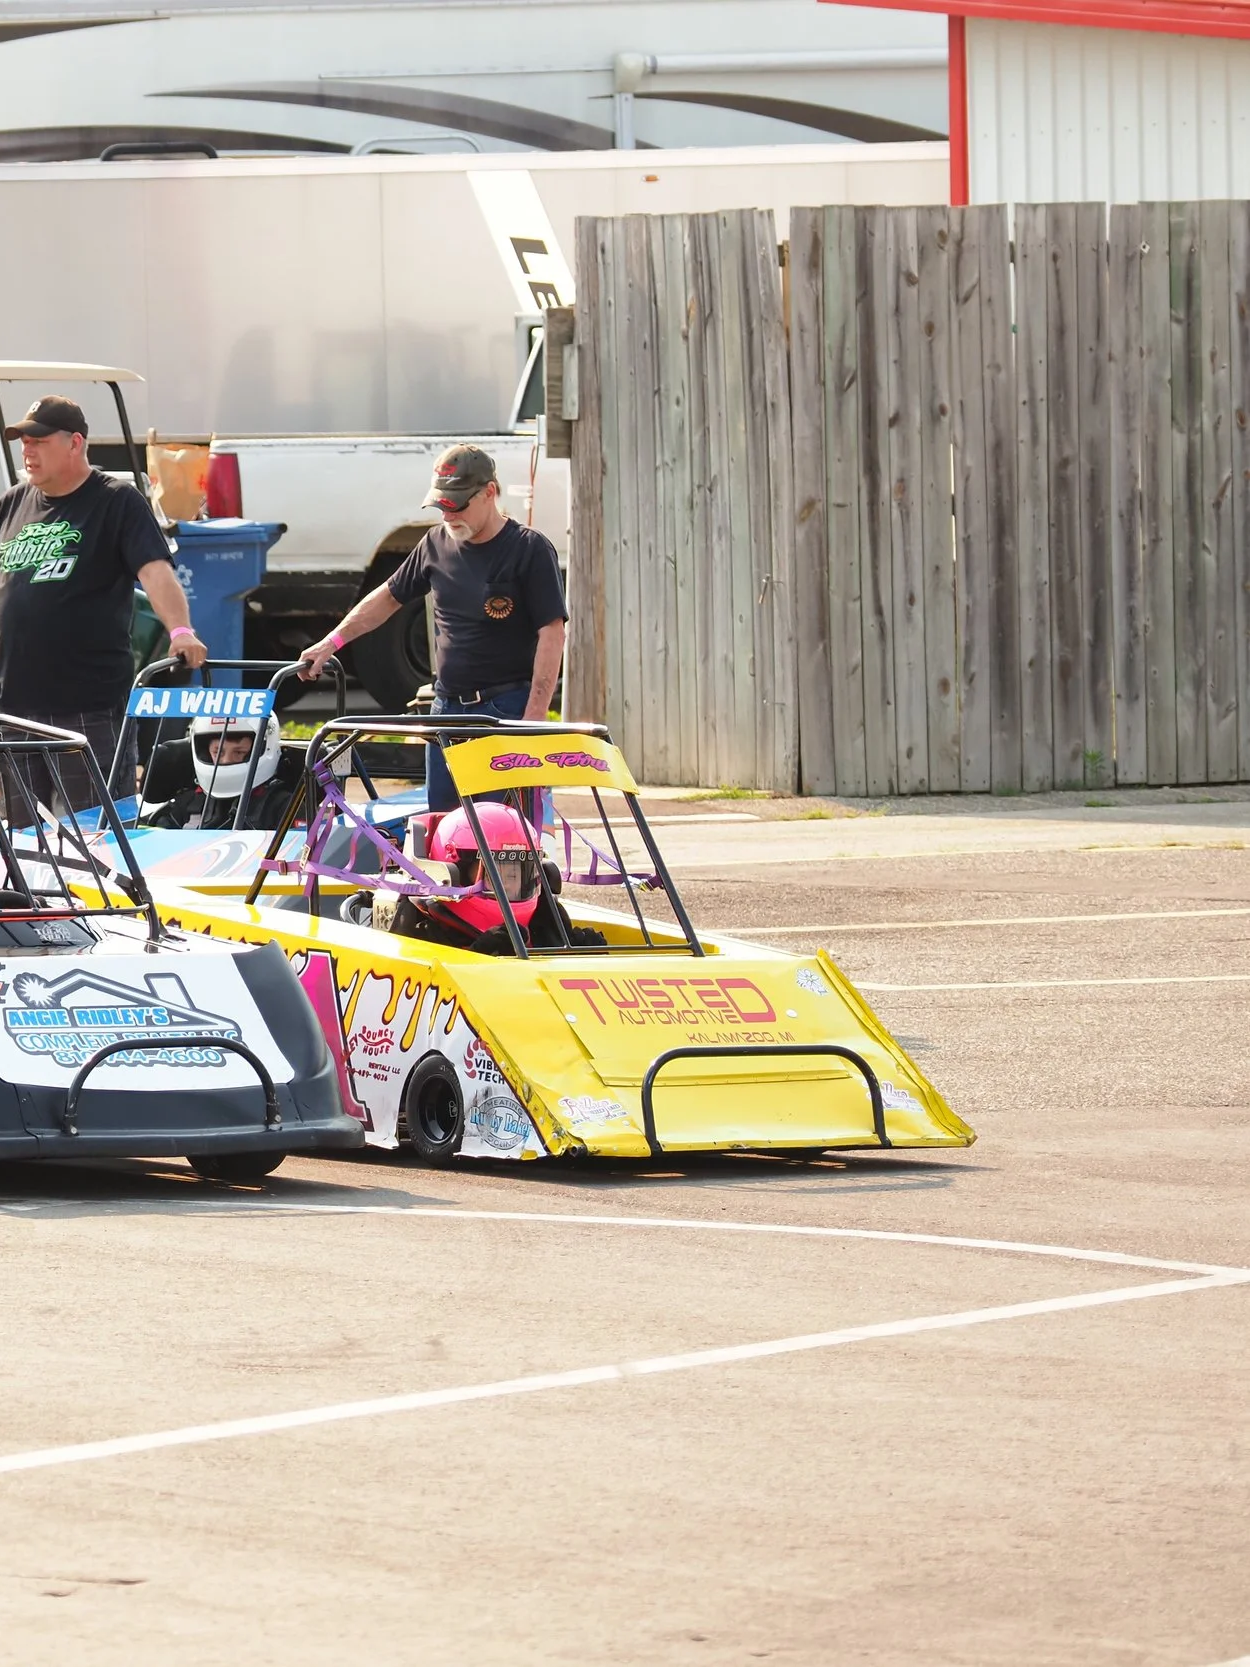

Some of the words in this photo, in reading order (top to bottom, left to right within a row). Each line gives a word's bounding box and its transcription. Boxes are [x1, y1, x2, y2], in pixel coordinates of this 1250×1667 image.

[31, 556, 77, 582] 20
[135, 691, 171, 715] AJ
[180, 690, 267, 715] WHITE
[489, 752, 543, 771] Ella
[559, 978, 776, 1025] TWISTED
[7, 1008, 71, 1027] ANGIE
[73, 1007, 171, 1027] RIDLEY'S
[618, 1009, 742, 1025] AUTOMOTIVE
[361, 1025, 394, 1040] BOUNCY
[362, 1045, 390, 1056] HOUSE
[478, 1071, 505, 1085] TECH
[504, 1113, 532, 1138] Baker
